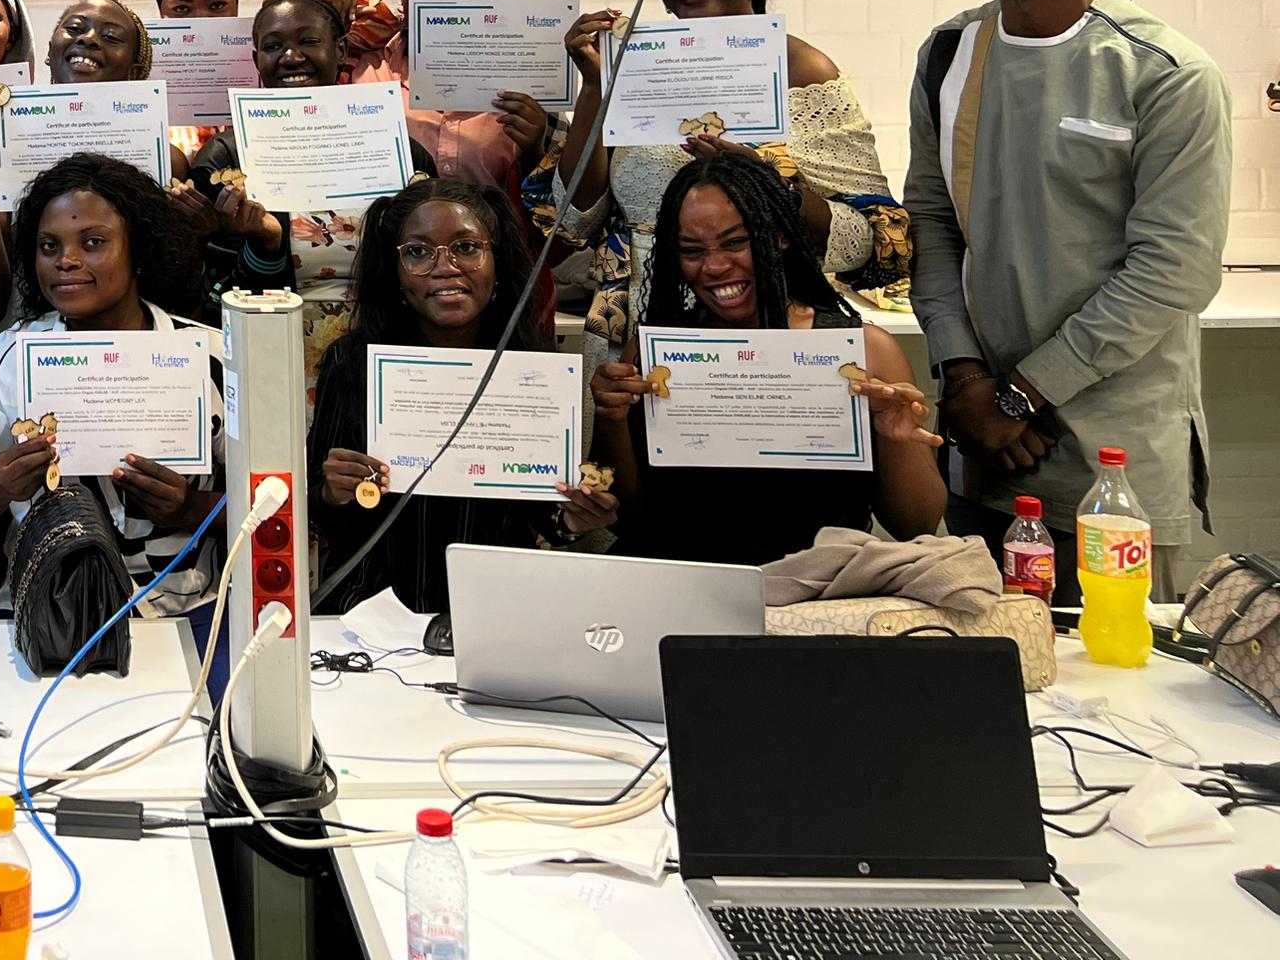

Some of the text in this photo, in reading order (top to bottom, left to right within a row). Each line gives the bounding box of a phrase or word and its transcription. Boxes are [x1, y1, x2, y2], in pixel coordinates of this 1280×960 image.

[484, 15, 498, 23] AUF
[183, 34, 195, 43] AUF
[680, 37, 695, 46] AUF
[628, 41, 665, 51] AMOUM
[70, 102, 84, 112] AUF
[303, 106, 318, 115] AUF
[78, 120, 111, 128] participation
[104, 353, 119, 363] AUF
[737, 350, 755, 360] AUF
[113, 375, 150, 383] participation
[485, 443, 514, 451] Certificat
[468, 464, 485, 475] AUF
